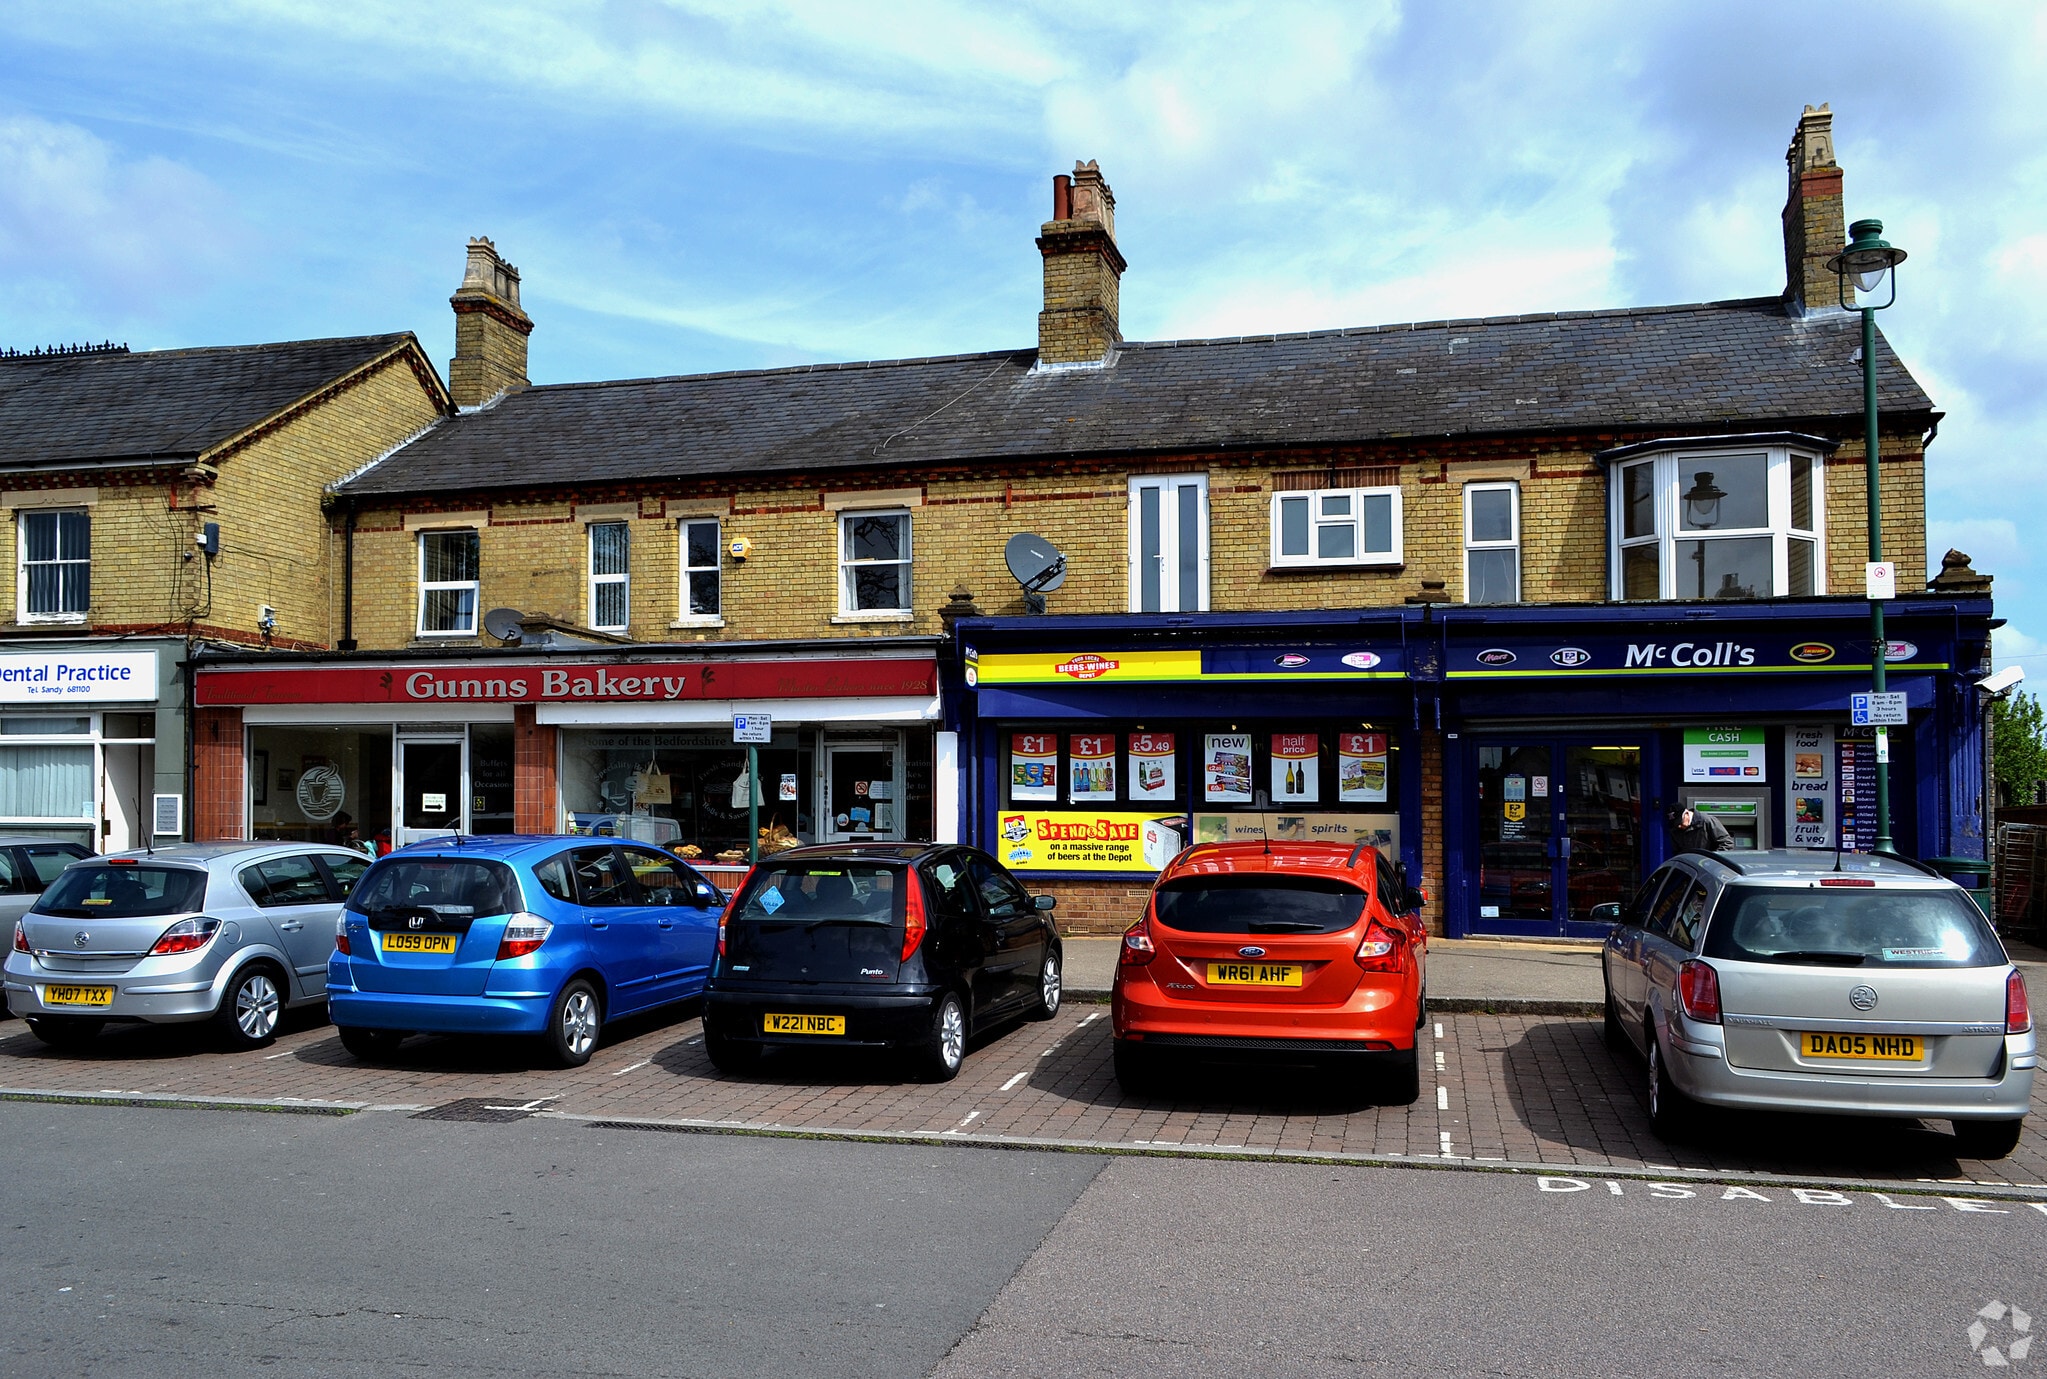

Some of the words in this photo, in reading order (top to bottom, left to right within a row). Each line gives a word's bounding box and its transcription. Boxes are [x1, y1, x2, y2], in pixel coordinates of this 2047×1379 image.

[0, 664, 48, 682] ental
[56, 664, 131, 681] Practice
[41, 686, 64, 694] Sandy
[67, 685, 91, 693] 681100
[405, 671, 528, 699] Gunns
[541, 669, 686, 699] Bakery
[901, 680, 928, 690] 1928
[583, 735, 615, 746] Home
[618, 734, 633, 746] of
[635, 734, 650, 746] the
[654, 734, 726, 746] Bedfordshire
[1282, 735, 1306, 746] half
[1708, 733, 1740, 742] CASH
[1795, 731, 1823, 739] fresh
[1022, 735, 1044, 753] £1
[1079, 737, 1102, 755] £1
[1133, 735, 1170, 752] £5.49
[1350, 735, 1374, 753] £1
[1795, 739, 1819, 748] food
[1283, 745, 1306, 755] price
[482, 769, 493, 777] for
[496, 769, 506, 777] all
[1791, 781, 1829, 791] bread
[1234, 825, 1264, 834] wines
[1311, 823, 1348, 834] spirits
[1794, 825, 1820, 834] fruit
[1795, 834, 1804, 843] &
[1806, 836, 1826, 845] veg
[1069, 842, 1104, 851] massive
[1105, 844, 1130, 852] range
[1047, 852, 1056, 860] of
[1057, 852, 1081, 861] beers
[1082, 853, 1091, 861] at
[1093, 852, 1107, 861] the
[1108, 853, 1132, 862] Depot
[387, 935, 421, 949] LO59
[424, 936, 450, 950] OPN
[1217, 964, 1254, 981] WR61
[1259, 966, 1292, 982] AHF
[51, 987, 81, 1001] YH07
[84, 988, 107, 1002] TXX
[772, 1015, 803, 1030] W221
[807, 1016, 835, 1031] NBC
[1811, 1034, 1866, 1055] DA05
[1872, 1036, 1914, 1057] NHD
[1537, 1175, 2047, 1223] DISABLE
